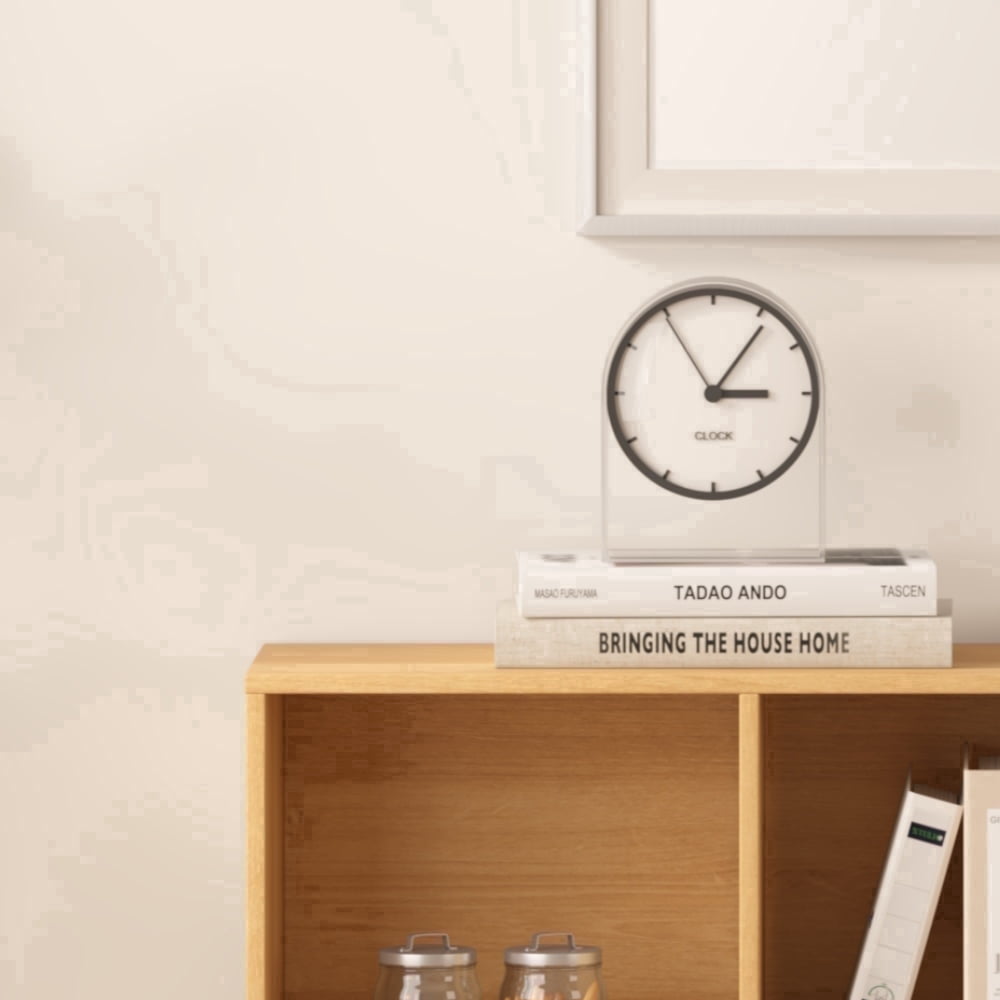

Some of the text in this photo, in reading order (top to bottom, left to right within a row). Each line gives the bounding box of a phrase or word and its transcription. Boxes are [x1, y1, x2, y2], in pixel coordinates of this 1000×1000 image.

[693, 431, 734, 441] CLOCK
[673, 584, 787, 600] TADAO ANDO
[880, 584, 927, 598] TASCEN
[599, 631, 850, 654] BRINGING THE HOUSE HOME
